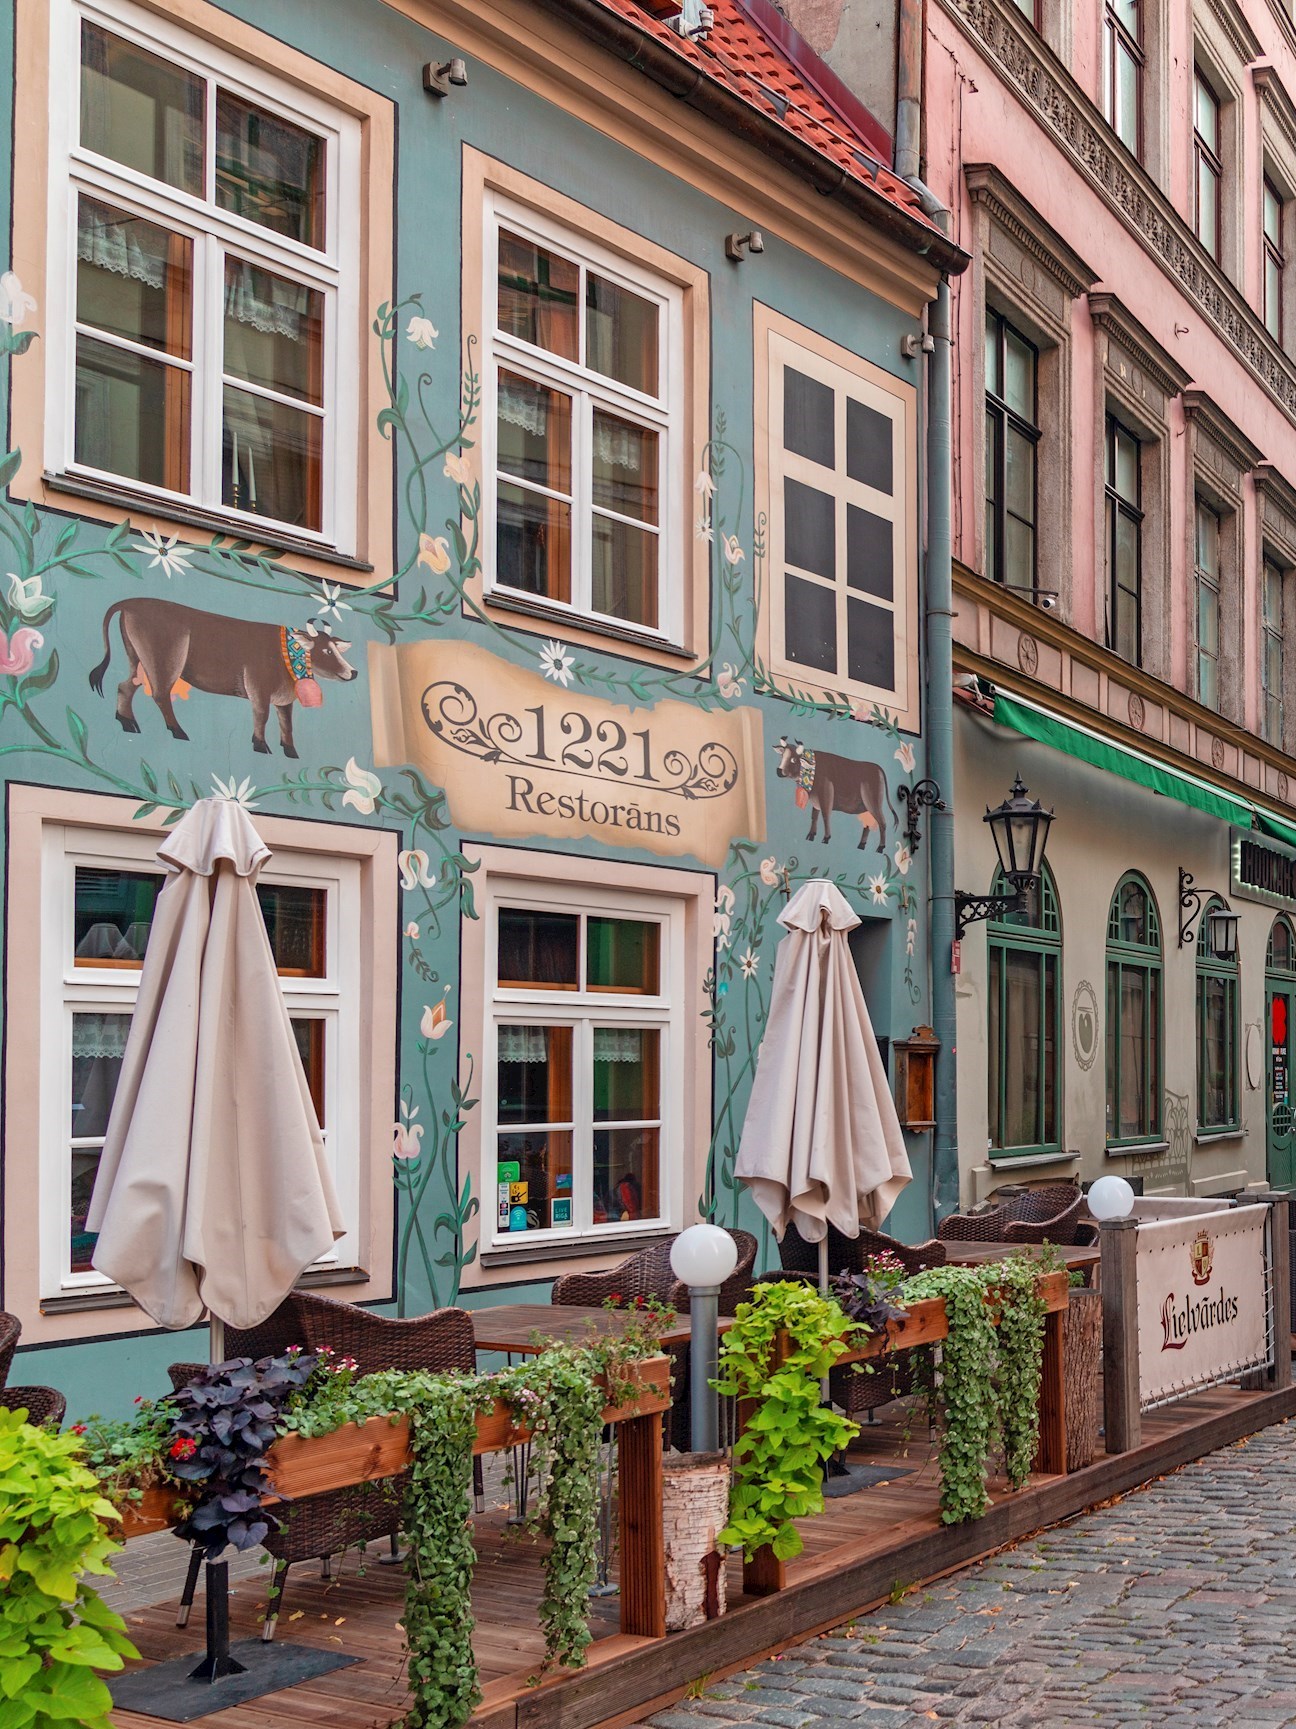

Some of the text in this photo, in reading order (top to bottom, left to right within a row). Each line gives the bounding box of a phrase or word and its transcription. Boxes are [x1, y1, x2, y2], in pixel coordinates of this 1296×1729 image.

[524, 704, 660, 782] 1221
[505, 774, 682, 837] Restorāns
[1241, 841, 1290, 898] HOOKAH
[1159, 1287, 1239, 1352] Lielvārdes
